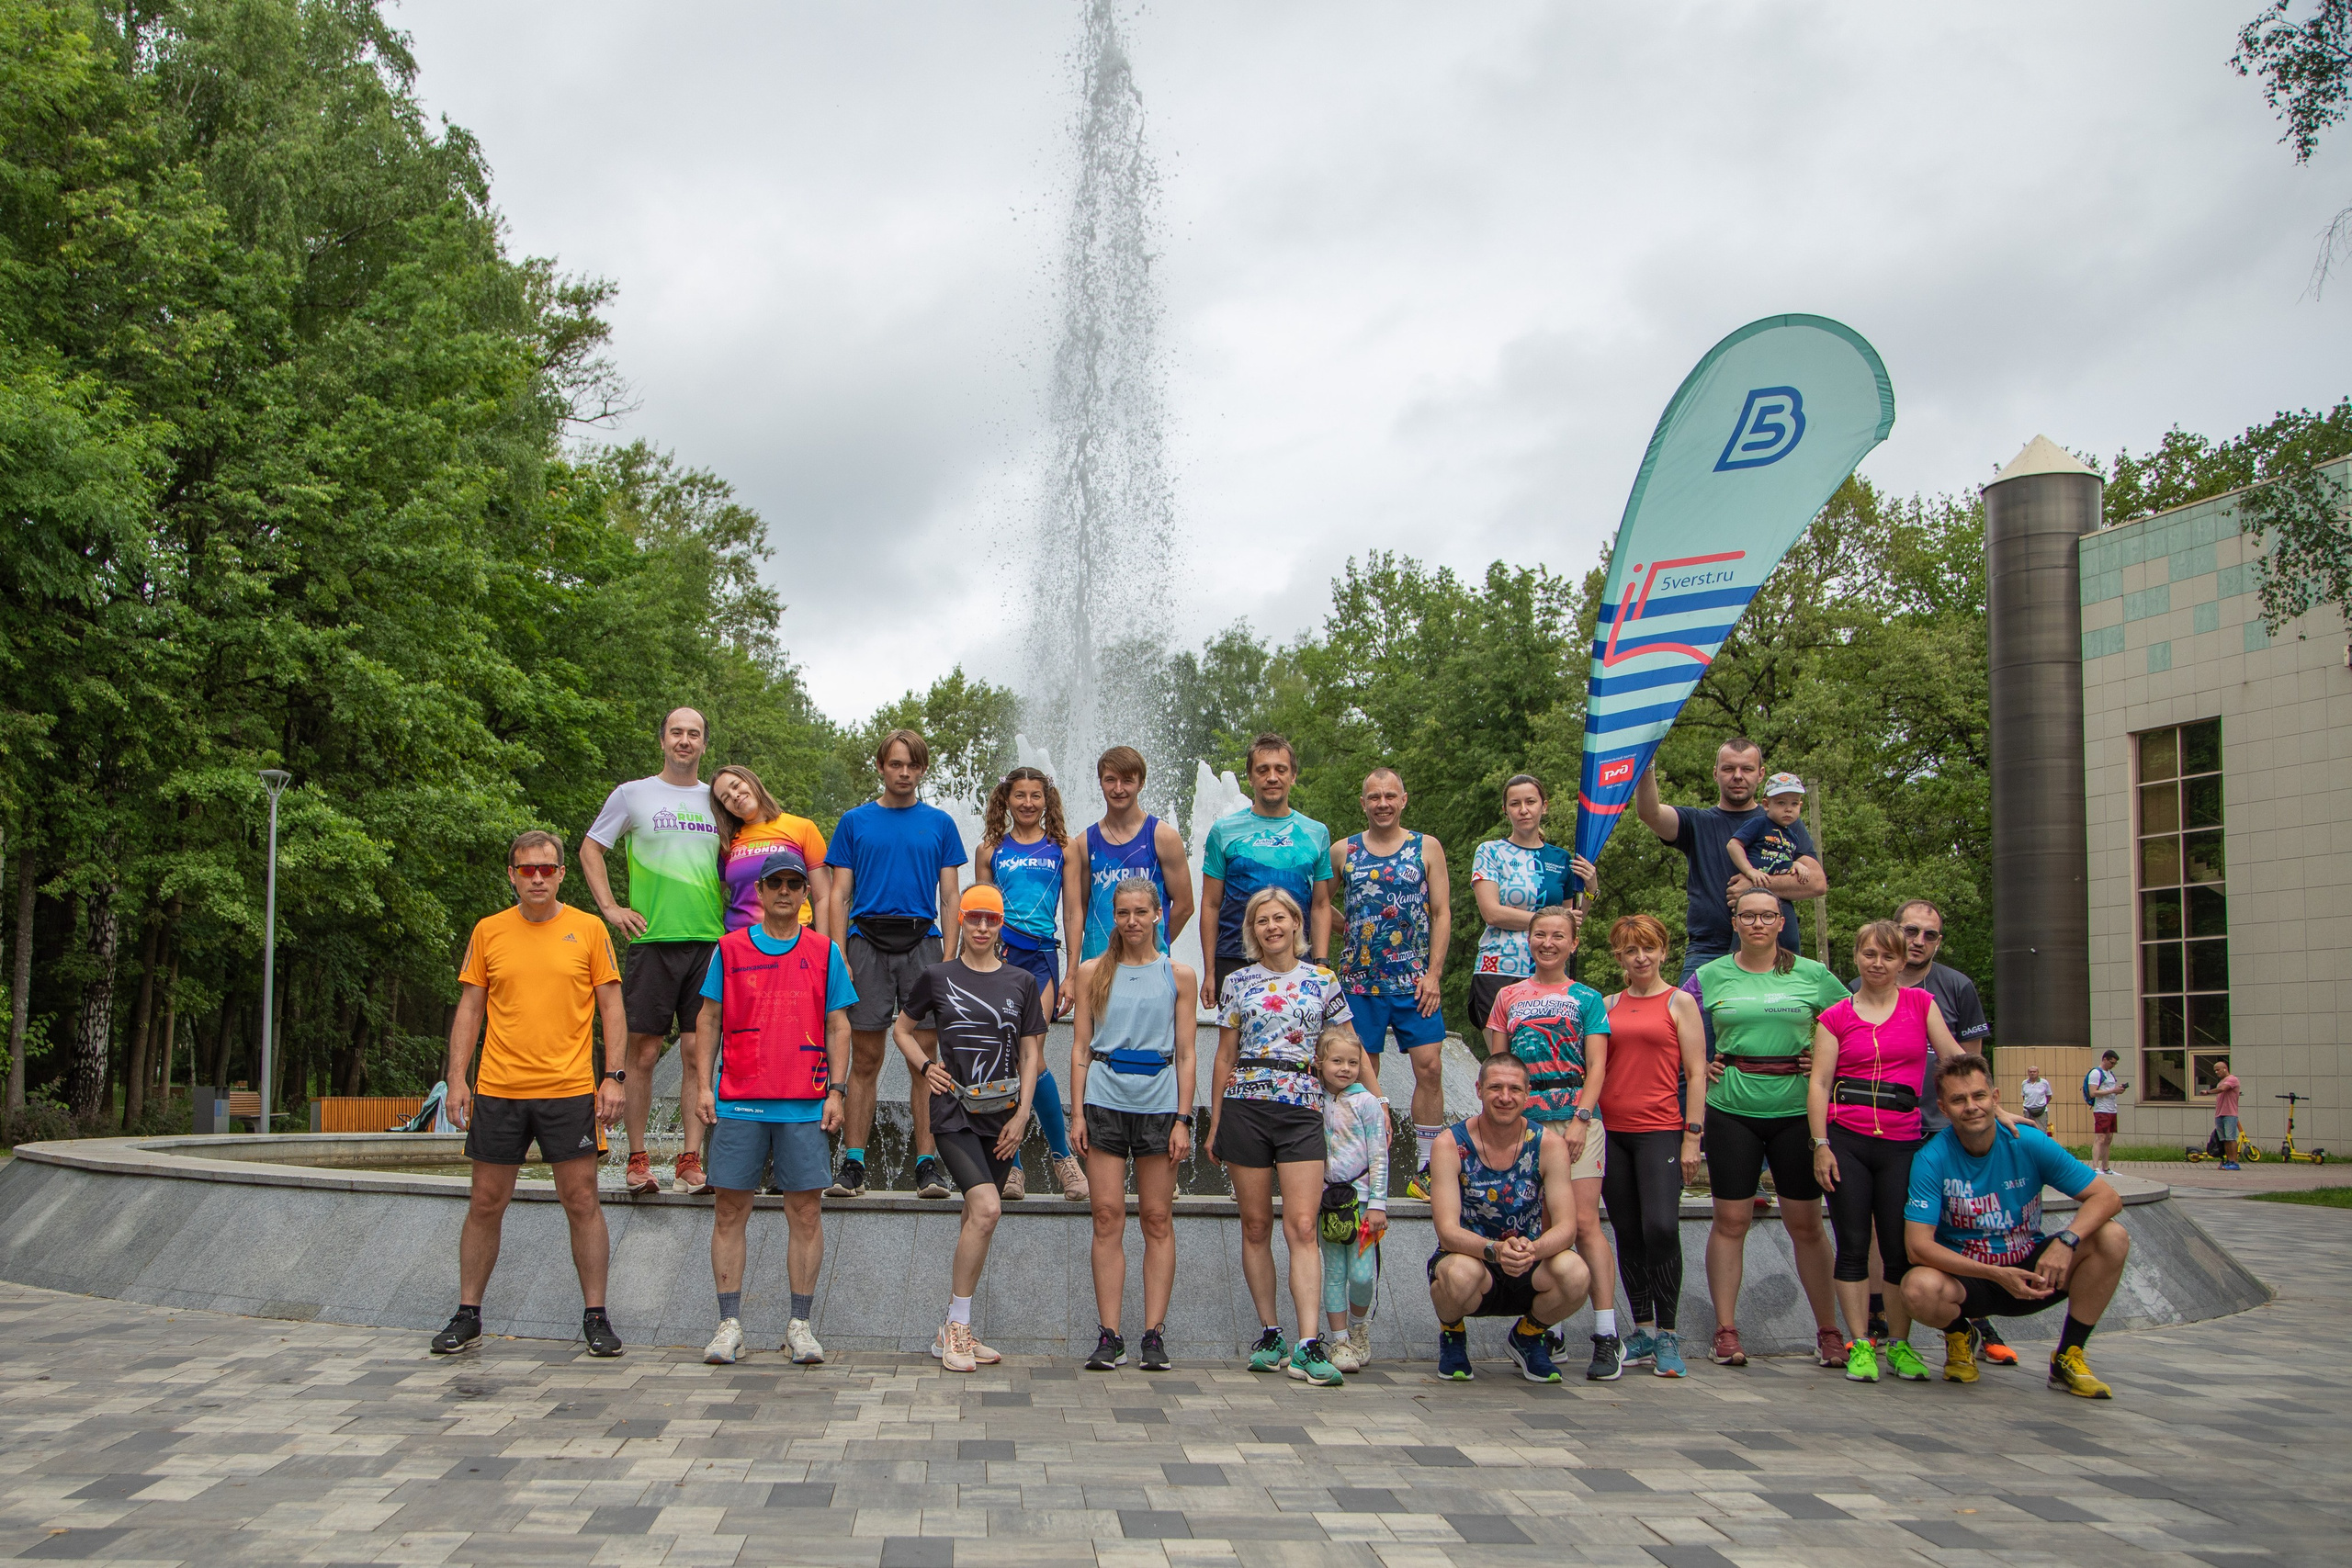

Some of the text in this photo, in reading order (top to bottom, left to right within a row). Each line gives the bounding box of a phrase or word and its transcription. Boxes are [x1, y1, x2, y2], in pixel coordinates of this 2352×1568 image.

[1661, 570, 1734, 591] 5verst.ru
[677, 813, 703, 822] RUN
[747, 845, 786, 855] TONDA
[731, 962, 778, 974] Замыкающий
[1550, 1009, 1578, 1022] TRAIL
[1949, 1192, 2001, 1216] #МЕЧТА
[1952, 1213, 1976, 1229] БЕГ
[1976, 1209, 2014, 1230] 2024
